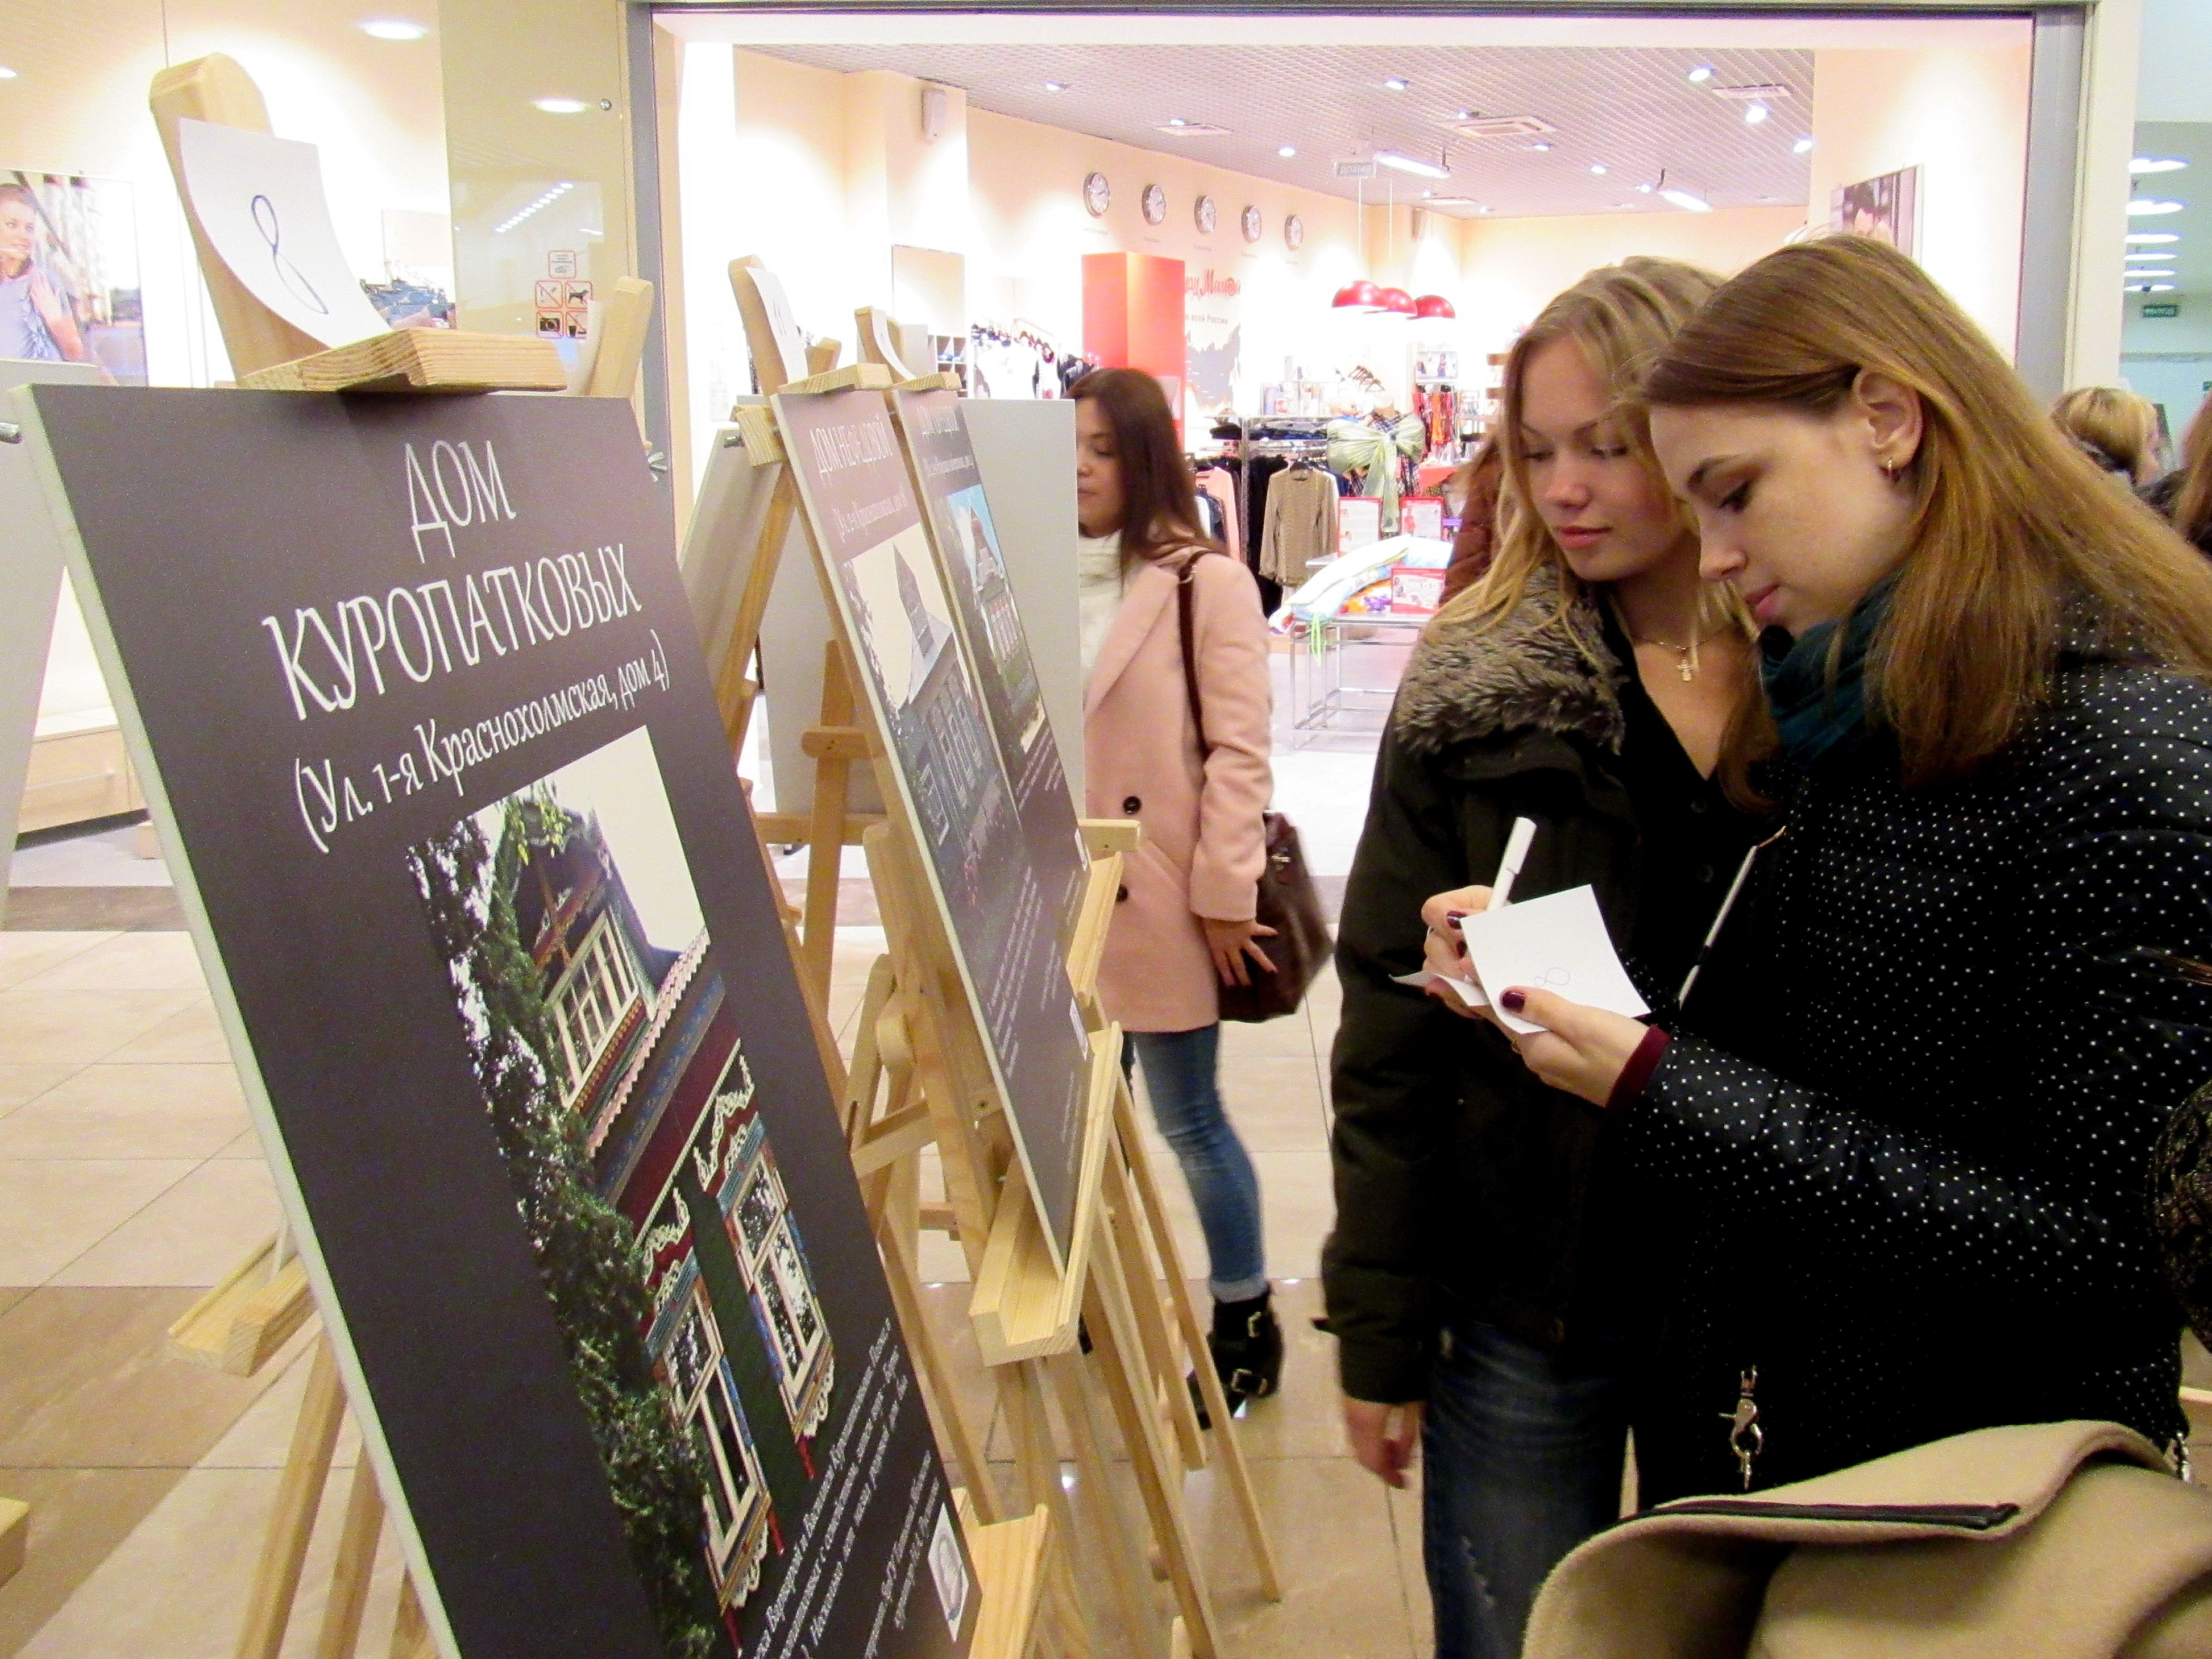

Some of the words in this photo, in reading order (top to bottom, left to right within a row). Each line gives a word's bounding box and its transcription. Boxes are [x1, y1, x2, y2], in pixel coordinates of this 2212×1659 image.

[405, 439, 516, 563] ДОМ
[262, 542, 642, 721] КУРОПАТКОВЫХ
[294, 757, 373, 854] (Ул.
[372, 750, 424, 803] 1-я
[414, 670, 617, 797] Краснохолмская,
[617, 660, 650, 711] дом
[649, 628, 670, 692] 4)
